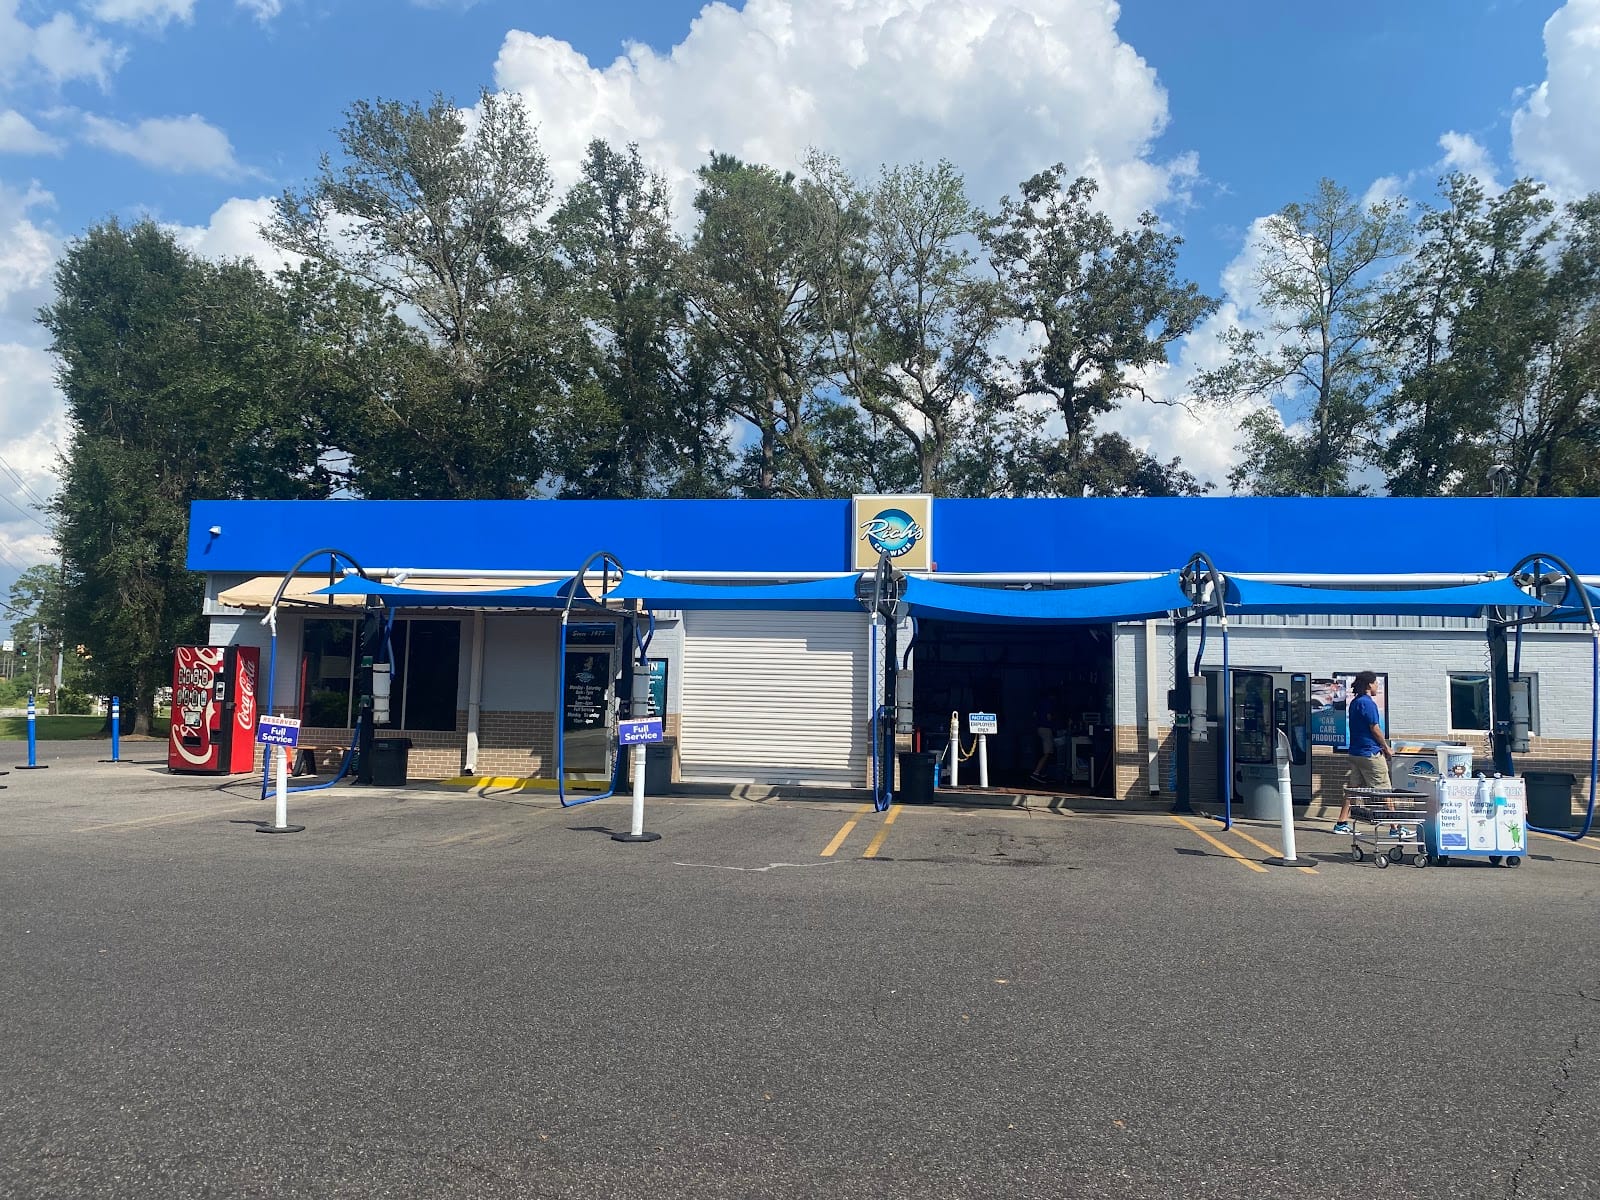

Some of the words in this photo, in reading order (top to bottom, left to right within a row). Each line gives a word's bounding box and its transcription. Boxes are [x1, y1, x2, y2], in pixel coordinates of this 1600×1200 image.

[860, 518, 924, 542] Rich's
[890, 543, 912, 556] WASH
[263, 716, 298, 726] RESERVED
[1321, 717, 1335, 725] CAR
[271, 727, 287, 736] Full
[633, 724, 649, 733] Full
[1319, 725, 1337, 734] CARE
[262, 733, 293, 744] Service
[624, 731, 658, 741] Service
[1311, 733, 1345, 742] PRODUCTS
[1441, 820, 1456, 828] here
